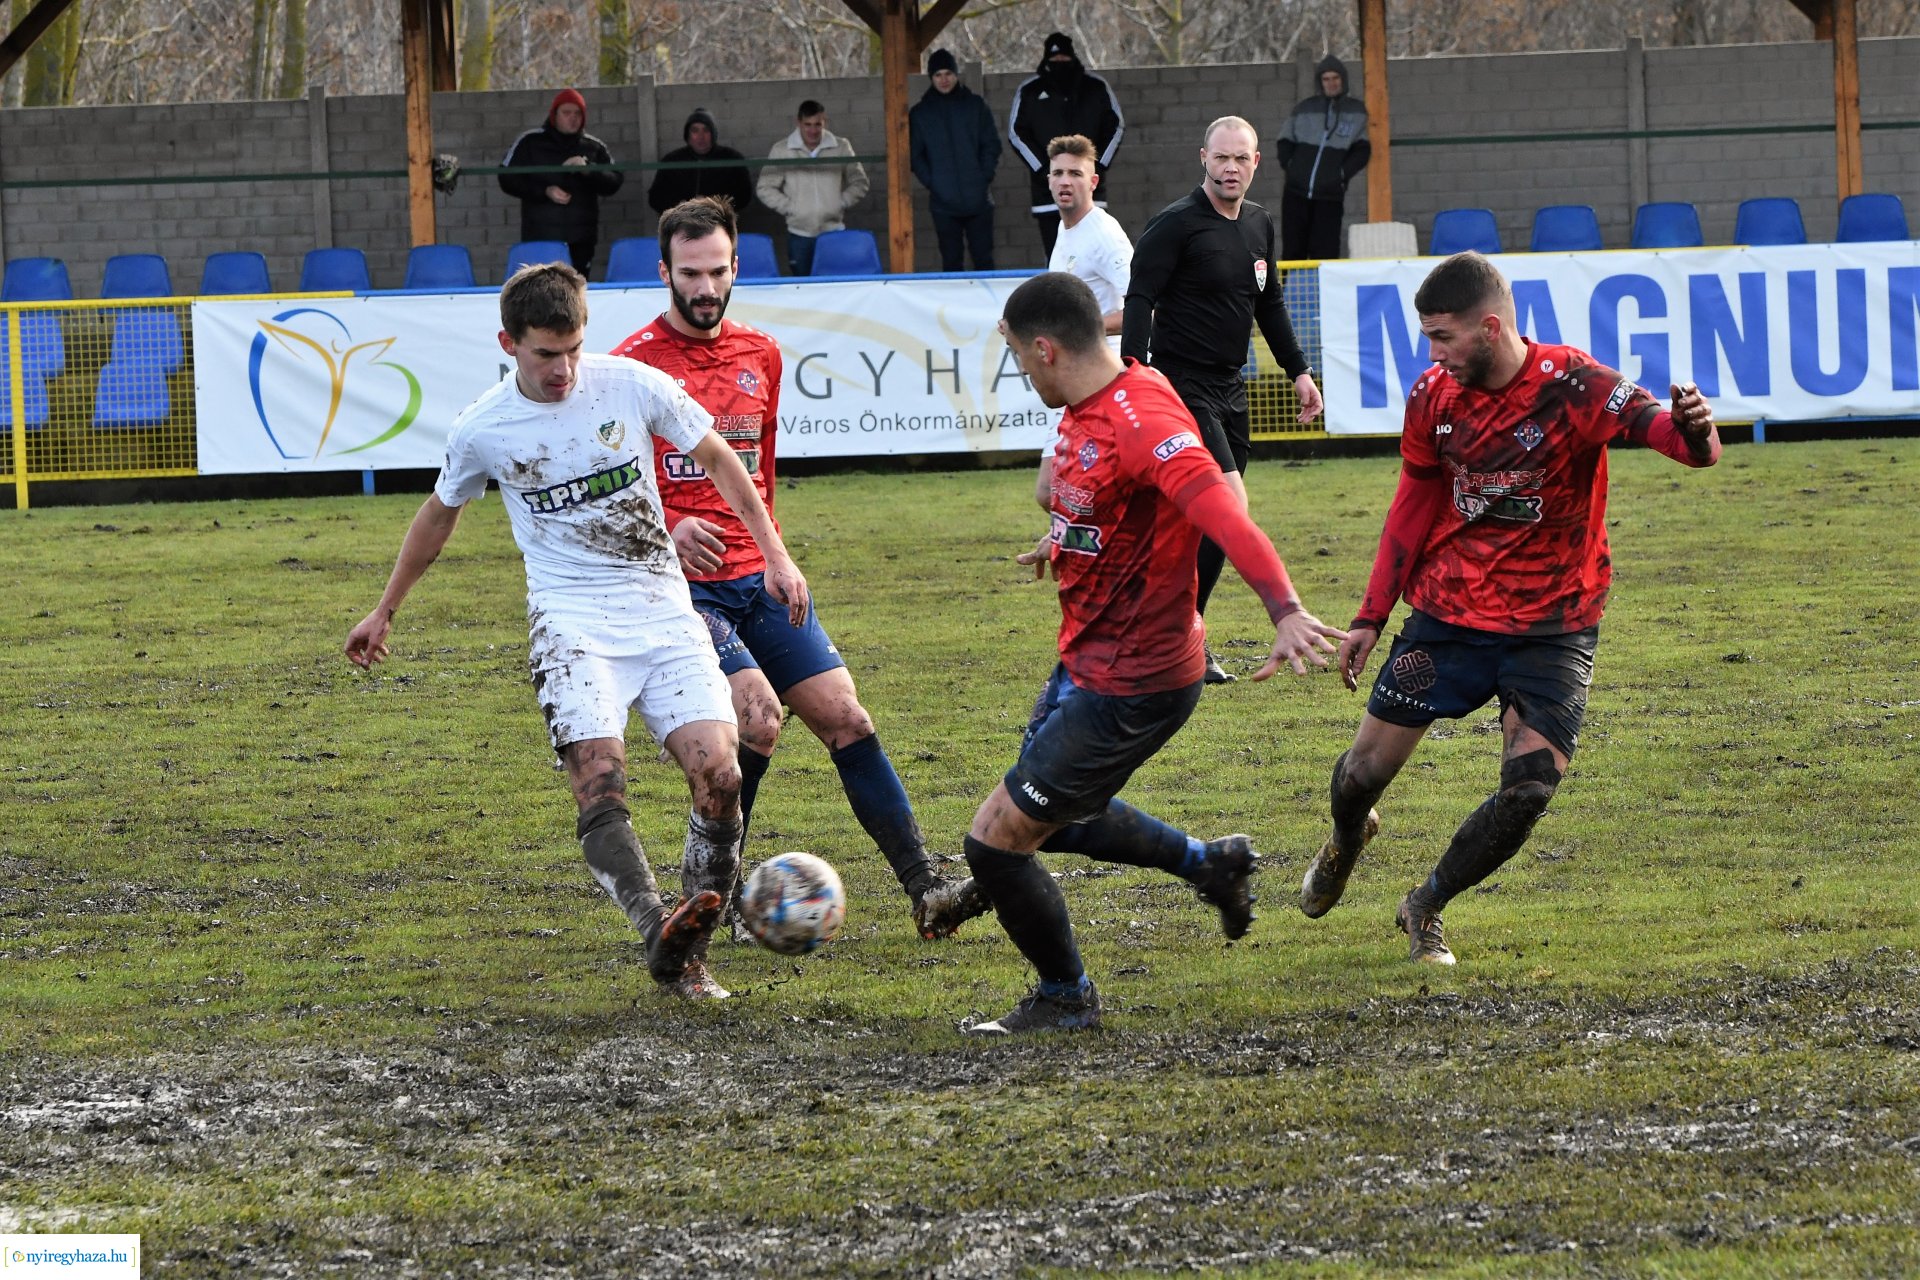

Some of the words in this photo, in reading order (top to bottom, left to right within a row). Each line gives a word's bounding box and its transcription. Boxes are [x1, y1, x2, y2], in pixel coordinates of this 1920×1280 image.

[781, 415, 850, 435] Város
[859, 409, 1048, 433] Önkormányzata
[1021, 781, 1049, 807] JAKO
